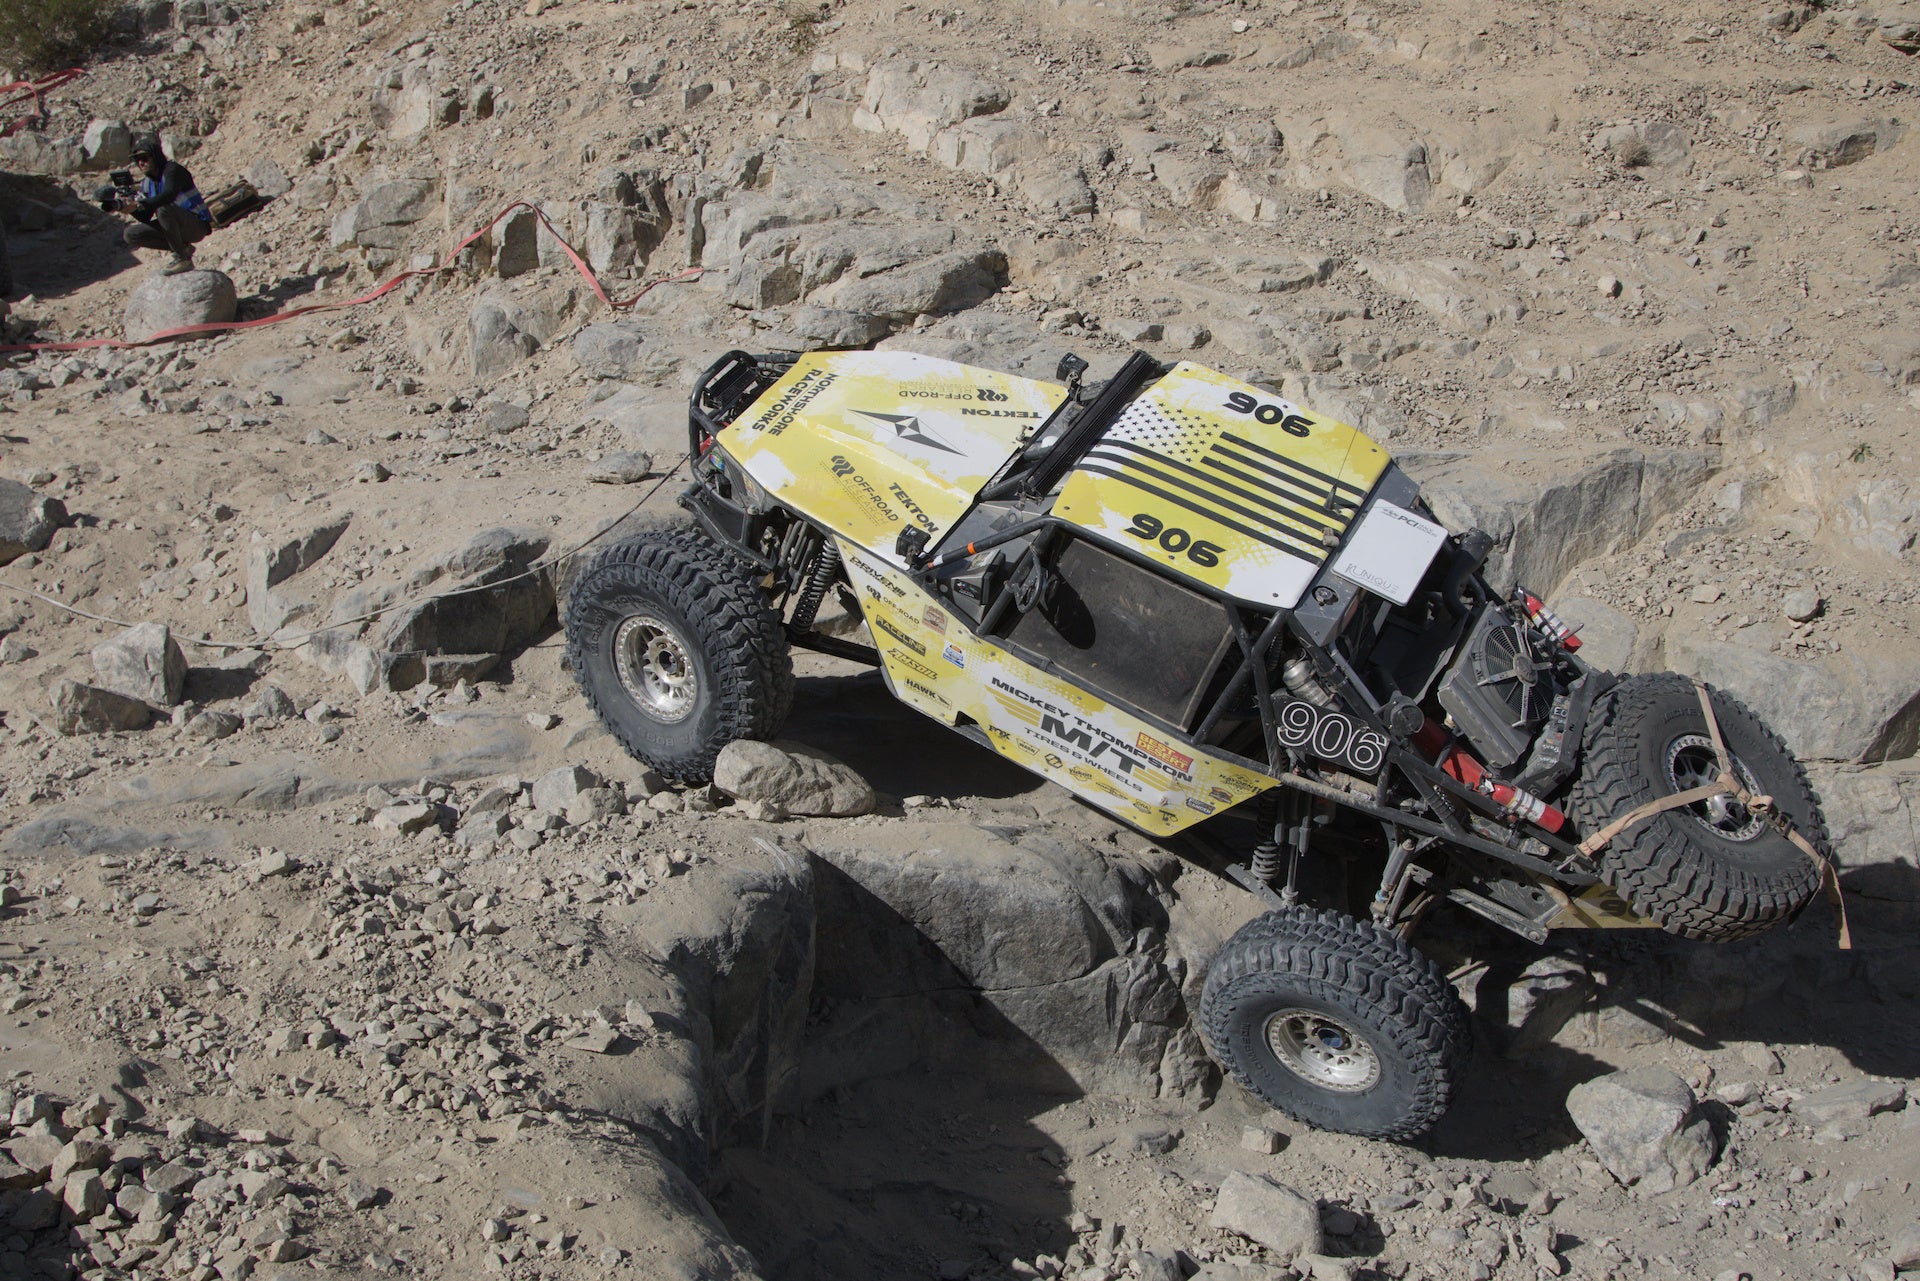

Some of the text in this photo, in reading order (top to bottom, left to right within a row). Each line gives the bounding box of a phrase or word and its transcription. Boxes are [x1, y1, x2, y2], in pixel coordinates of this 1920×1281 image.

[752, 368, 823, 432] RACEWORKS
[768, 373, 839, 436] NORTHSHORE
[899, 390, 973, 401] OFF-ROAD
[961, 408, 1042, 419] TEKTON
[1222, 391, 1317, 438] 906
[853, 475, 899, 522] OFF-ROAD
[888, 482, 939, 533] TEKTON
[1398, 515, 1419, 528] PCI
[1123, 513, 1228, 568] 906
[849, 556, 904, 597] DRIVEN
[883, 597, 920, 625] OFF-ROAD
[905, 678, 937, 698] HAWK
[991, 676, 1071, 718] MICKEY
[1074, 716, 1193, 783] THOMPSON
[1041, 713, 1146, 774] M/T
[1139, 733, 1175, 756] BEST
[1277, 701, 1388, 771] 906
[1024, 726, 1070, 754] TIRES
[1085, 757, 1143, 792] WHEELS
[1137, 739, 1188, 769] DESERT
